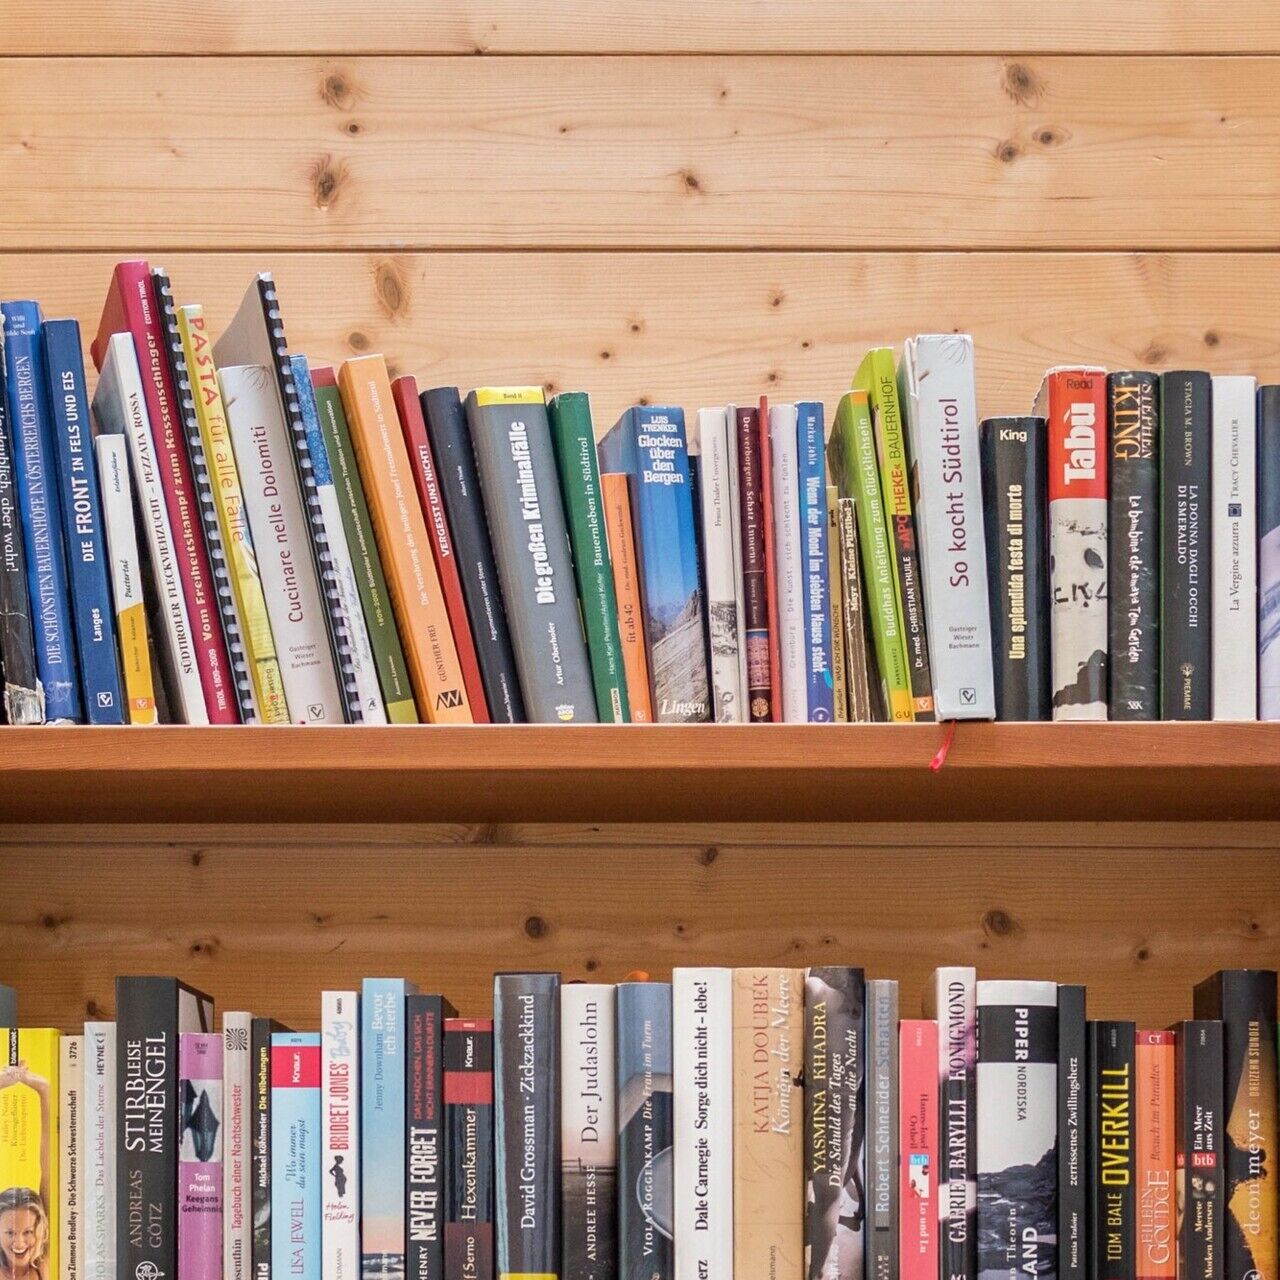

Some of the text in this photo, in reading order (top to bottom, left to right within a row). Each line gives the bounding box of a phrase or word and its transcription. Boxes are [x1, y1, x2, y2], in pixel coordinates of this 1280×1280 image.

[62, 371, 94, 561] DIE FRONT IN FELS UND EIS
[189, 317, 244, 541] PASTA für alle Fälle
[639, 435, 682, 448] Glocken
[649, 446, 675, 459] über
[653, 460, 674, 471] den
[1000, 429, 1027, 441] King
[1064, 403, 1095, 485] Tabù
[1, 497, 11, 527] aber
[251, 426, 303, 623] Cucinare nelle Dolomiti
[508, 422, 555, 604] Die großen Kriminalfälle
[580, 437, 603, 566] Bauernleben in Südtirol
[644, 473, 684, 486] Bergen
[939, 398, 969, 587] So kocht Südtirol
[1178, 485, 1186, 564] DI SMERALDO
[2, 530, 18, 572] wahr!
[859, 418, 897, 636] Buddhas Anleitung zum Glücklichsein
[1189, 485, 1198, 628] LA DONNA DAGLI OCCHI
[903, 556, 919, 633] CHRISTIAN THUILE
[1230, 558, 1242, 596] Vergine
[1230, 599, 1239, 611] La
[661, 700, 705, 715] Lingen
[580, 1003, 601, 1144] Der Judaslohn
[694, 982, 710, 1130] Sorge dich nicht lebe!
[754, 974, 768, 1134] KATJA DOUBEK
[1015, 1008, 1029, 1060] PIPER
[125, 1040, 145, 1151] STIRB LEISE
[146, 1032, 166, 1152] MEIN ENGEL
[330, 1060, 349, 1150] BRIDGET JONES'
[519, 995, 535, 1228] David Grossman Zickzackkind
[813, 1002, 826, 1173] YASMINA KHADRA
[1017, 1066, 1026, 1121] NORDISKA
[189, 1184, 215, 1192] Phelan
[410, 1126, 437, 1241] NEVER FORGET
[461, 1108, 476, 1219] Hexenkammer
[695, 1138, 710, 1231] Dale Carnegie
[1102, 1063, 1129, 1261] TOM BALE OVERKILL
[129, 1170, 142, 1248] ANDREAS
[149, 1203, 162, 1248] GÖTZ
[291, 1198, 304, 1274] LISA JEWELL
[466, 1237, 475, 1271] Serno
[586, 1165, 595, 1261] ANDREE HESSE
[1148, 1171, 1169, 1264] GOUDGE
